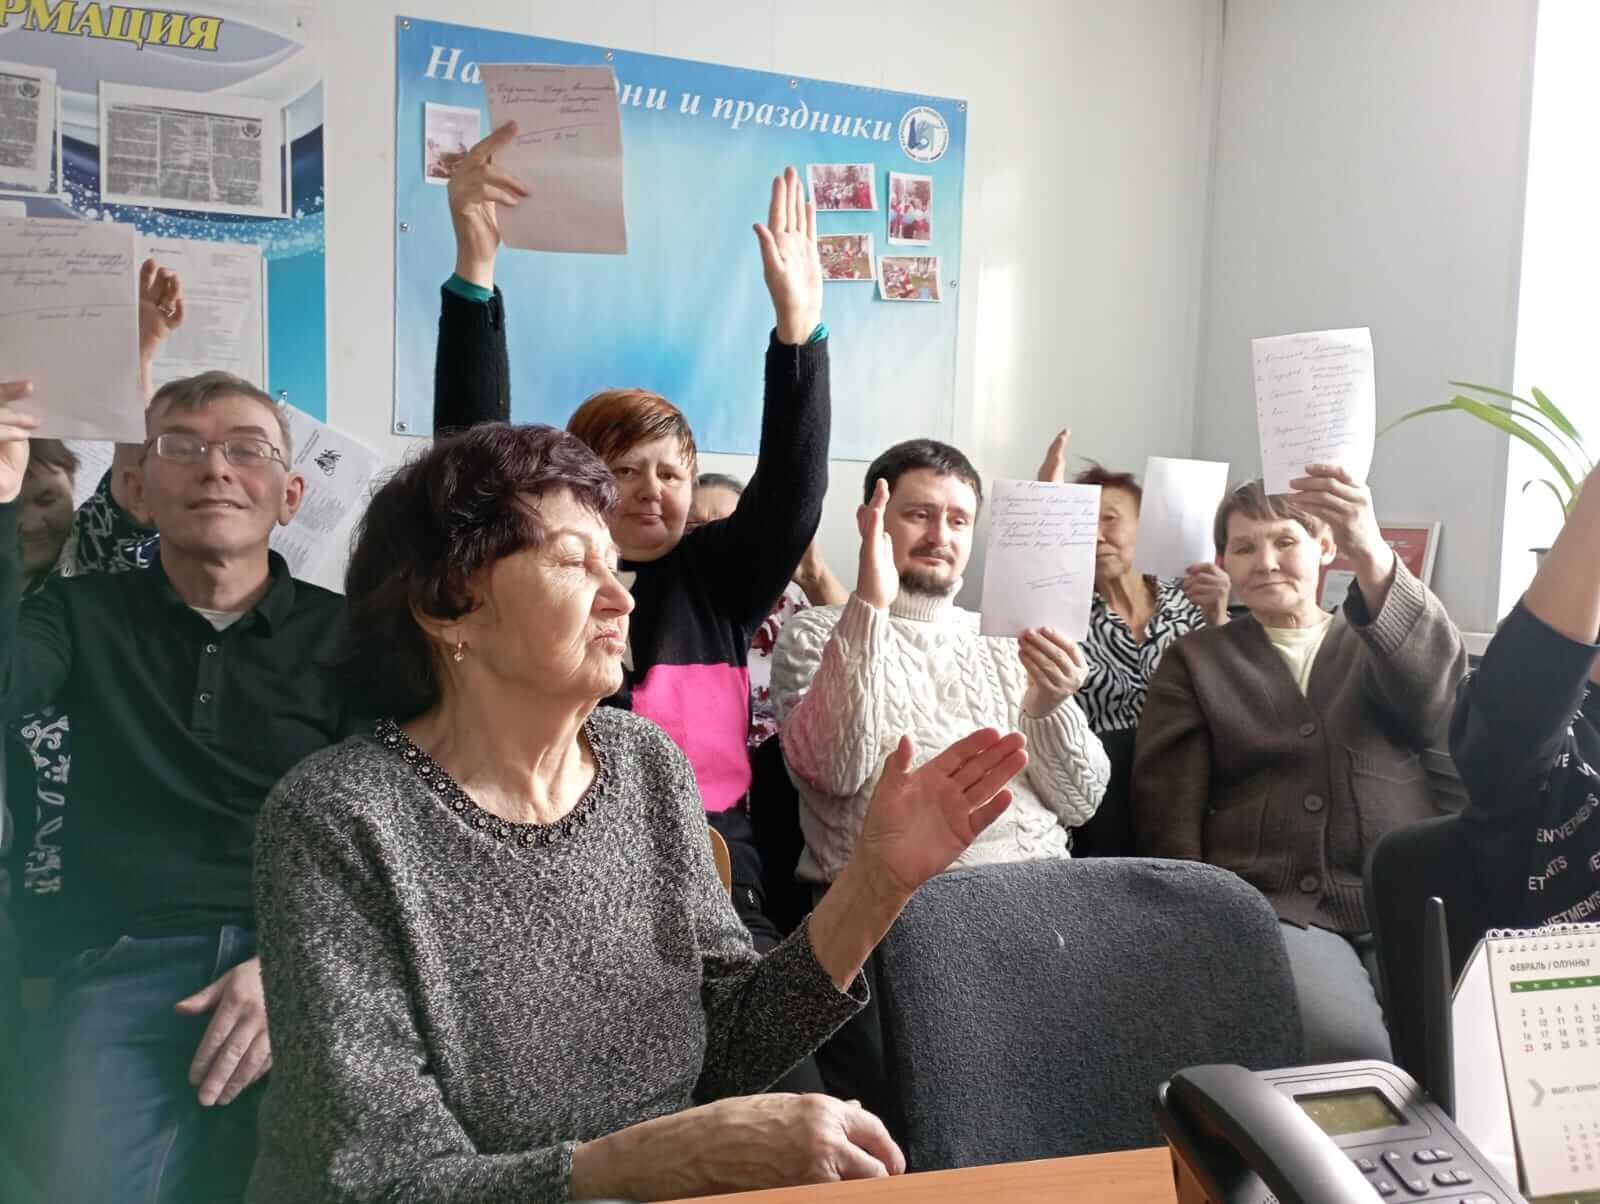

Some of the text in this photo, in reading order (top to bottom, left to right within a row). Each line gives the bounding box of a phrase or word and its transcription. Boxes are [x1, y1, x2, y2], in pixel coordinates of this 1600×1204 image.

[0, 0, 225, 51] РМАЦИЯ
[424, 45, 483, 85] На
[679, 92, 701, 115] и
[711, 97, 893, 142] праздники
[1510, 961, 1546, 973] ФЕВРАЛЬ
[1558, 1016, 1565, 1025] 11
[1575, 1015, 1584, 1024] 12
[1525, 1044, 1534, 1053] 23
